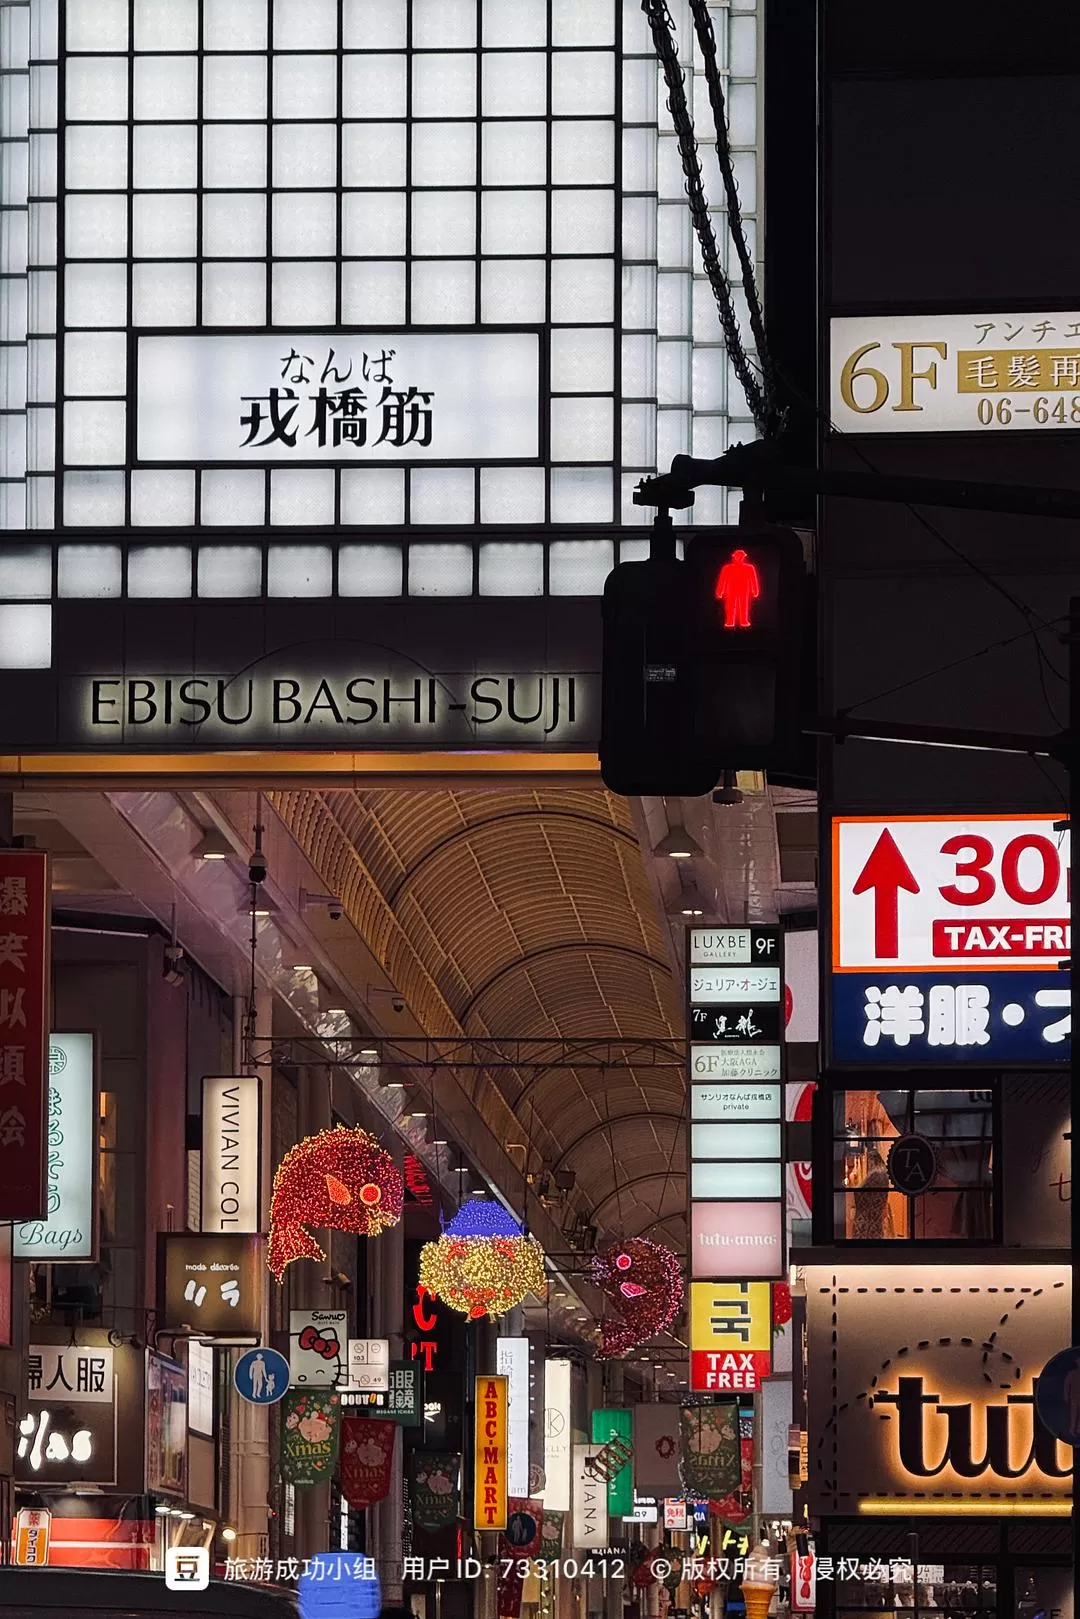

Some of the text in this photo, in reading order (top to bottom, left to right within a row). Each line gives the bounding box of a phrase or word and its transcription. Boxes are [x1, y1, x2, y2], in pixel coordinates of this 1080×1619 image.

[973, 320, 1080, 344] アンチエ
[280, 347, 396, 384] なんば
[840, 341, 948, 413] 6F
[965, 353, 1080, 388] 毛髪再
[239, 386, 435, 448] 戎橋筋
[92, 677, 577, 734] EBISU BASHI-SUJI
[938, 834, 1071, 906] 30
[694, 936, 775, 954] LUXBE 9F
[693, 978, 777, 991] ジュリア・オージェ
[692, 1009, 708, 1022] 7F
[694, 1055, 719, 1073] 6F
[723, 1103, 750, 1111] private
[222, 1087, 240, 1169] VIVIAN
[19, 1222, 83, 1251] Bags
[711, 1283, 752, 1342] 국
[707, 1353, 754, 1371] TAX
[706, 1372, 756, 1389] FREE
[340, 1393, 384, 1406] DOUTOR
